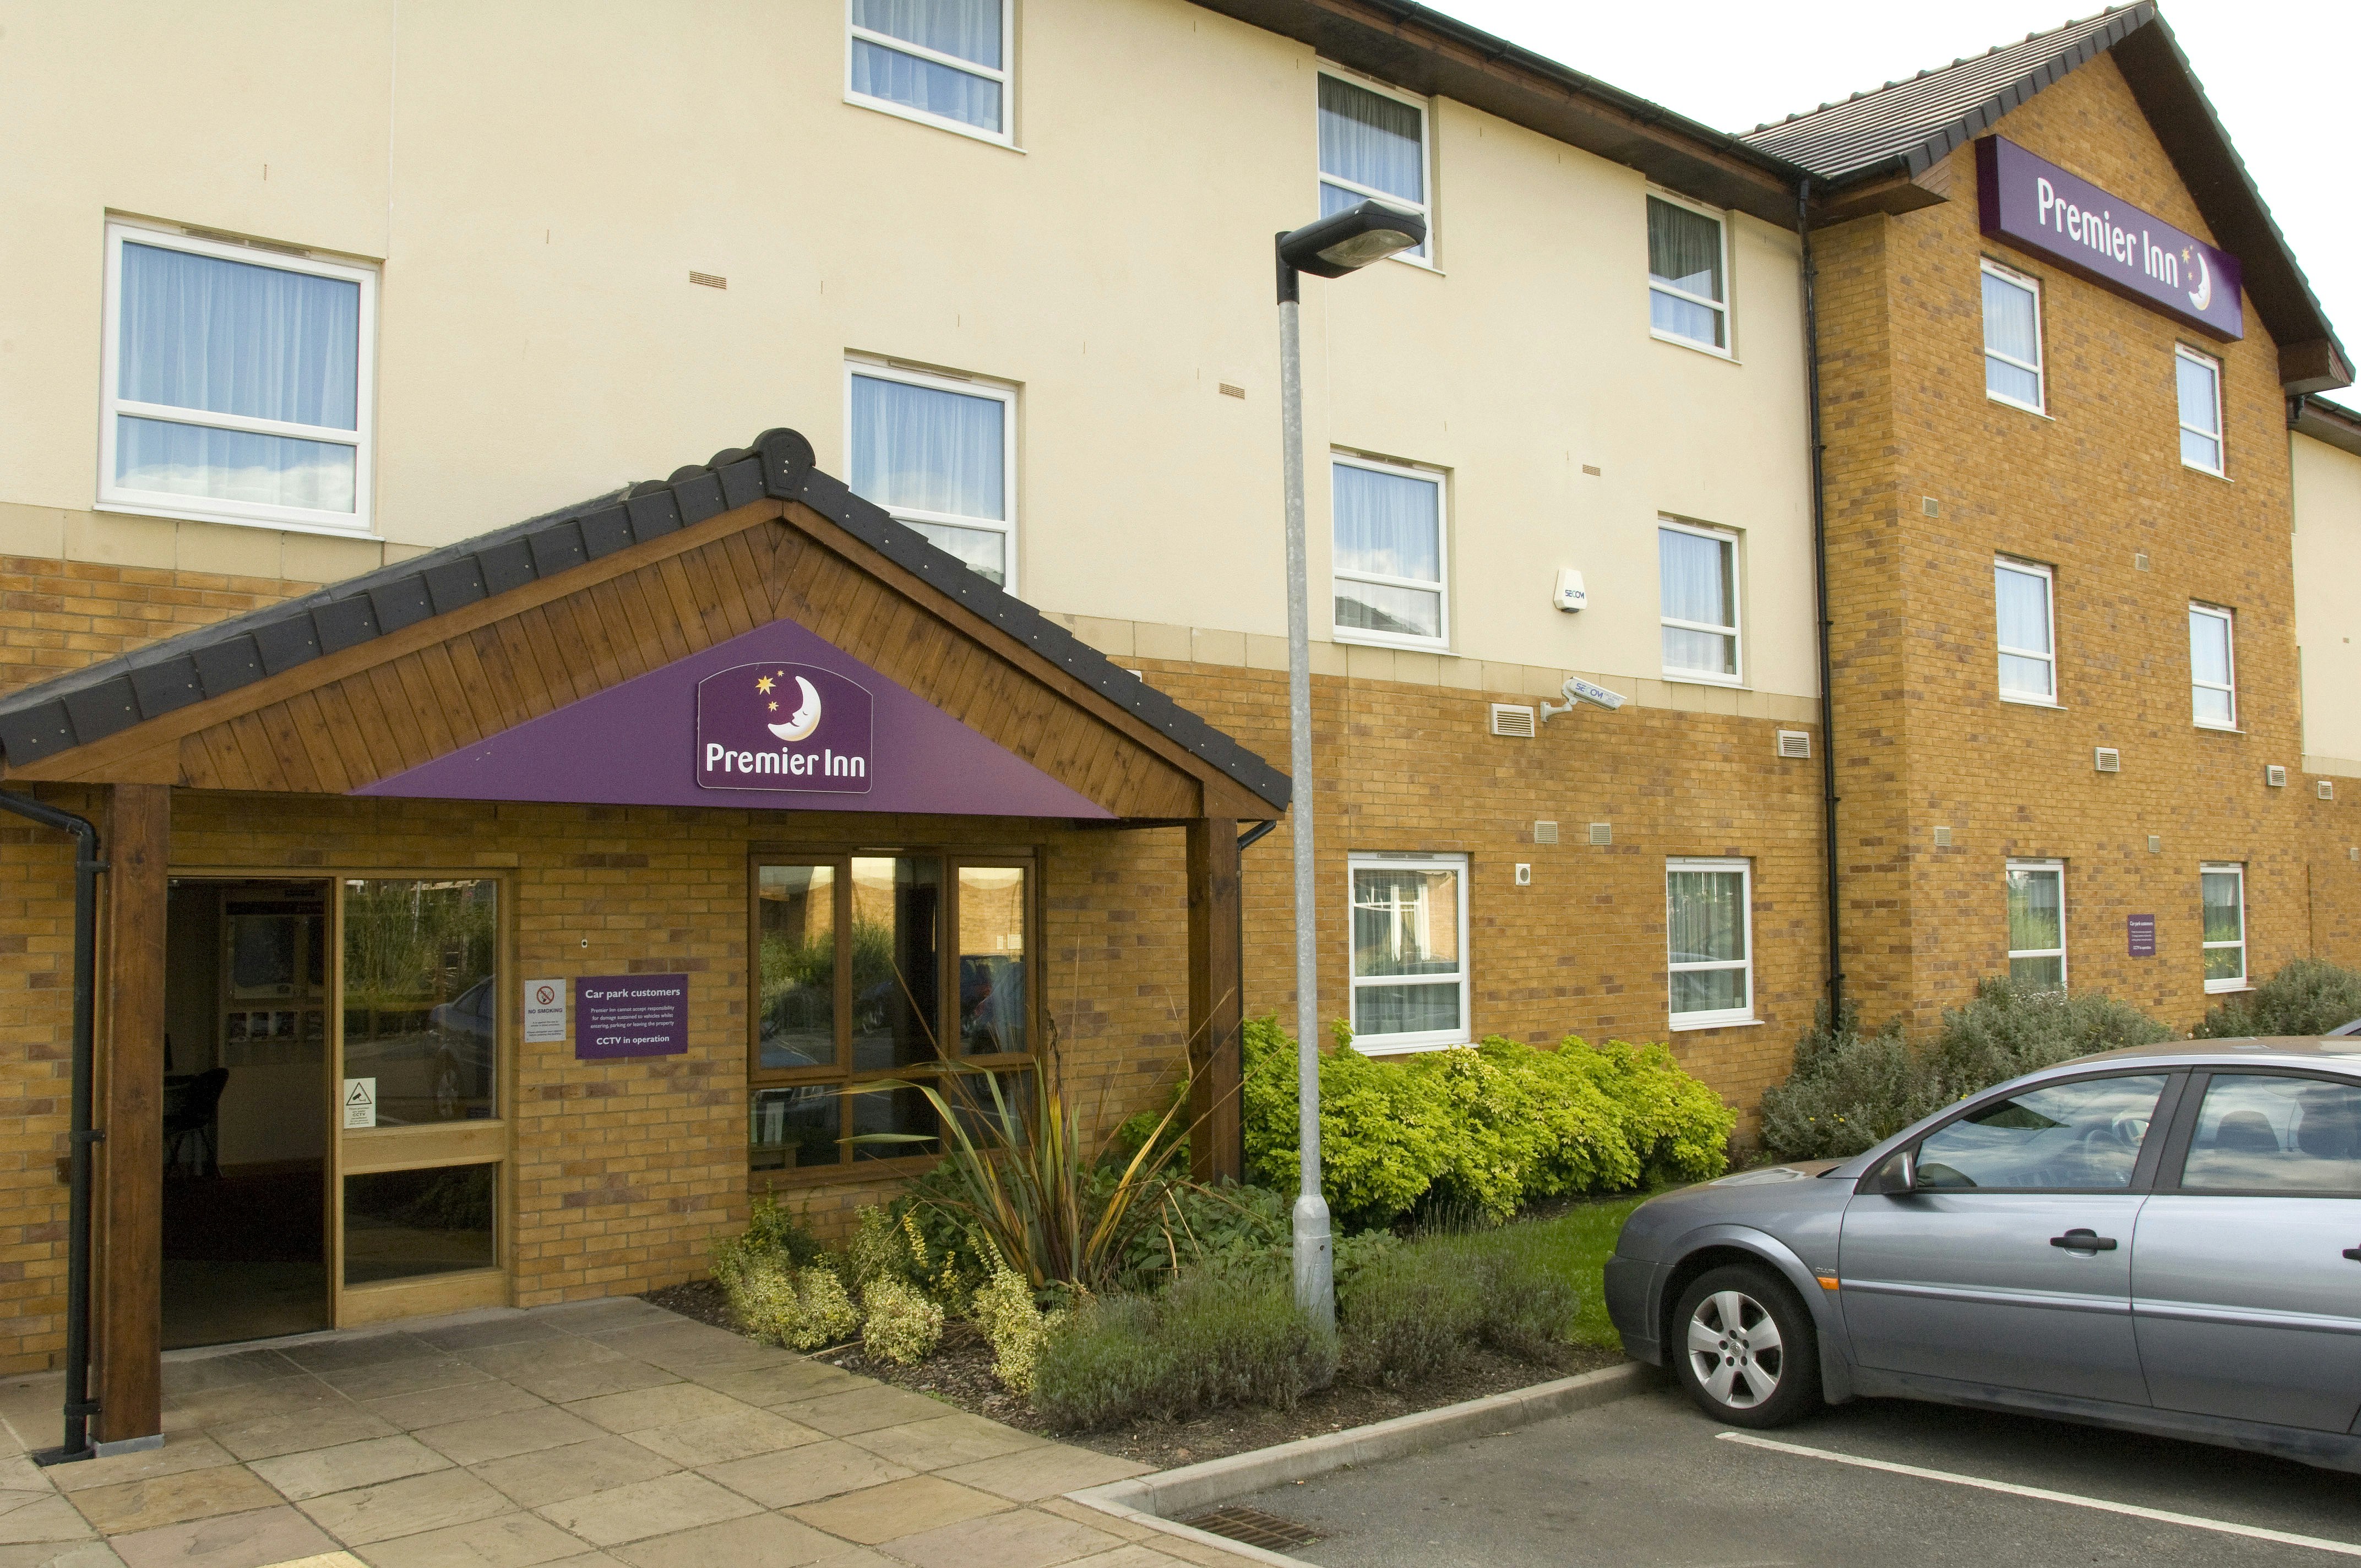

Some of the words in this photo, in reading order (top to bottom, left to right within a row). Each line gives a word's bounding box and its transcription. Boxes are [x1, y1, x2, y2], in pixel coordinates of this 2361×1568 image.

[2037, 177, 2136, 266] Premier
[2143, 230, 2178, 288] Inn
[1565, 589, 1585, 599] SECOM
[706, 743, 819, 775] Premier
[825, 749, 865, 777] Inn
[585, 989, 604, 998] Car
[606, 988, 628, 1000] park
[631, 989, 681, 997] customers
[596, 1037, 622, 1045] CCTV
[633, 1035, 670, 1045] operation
